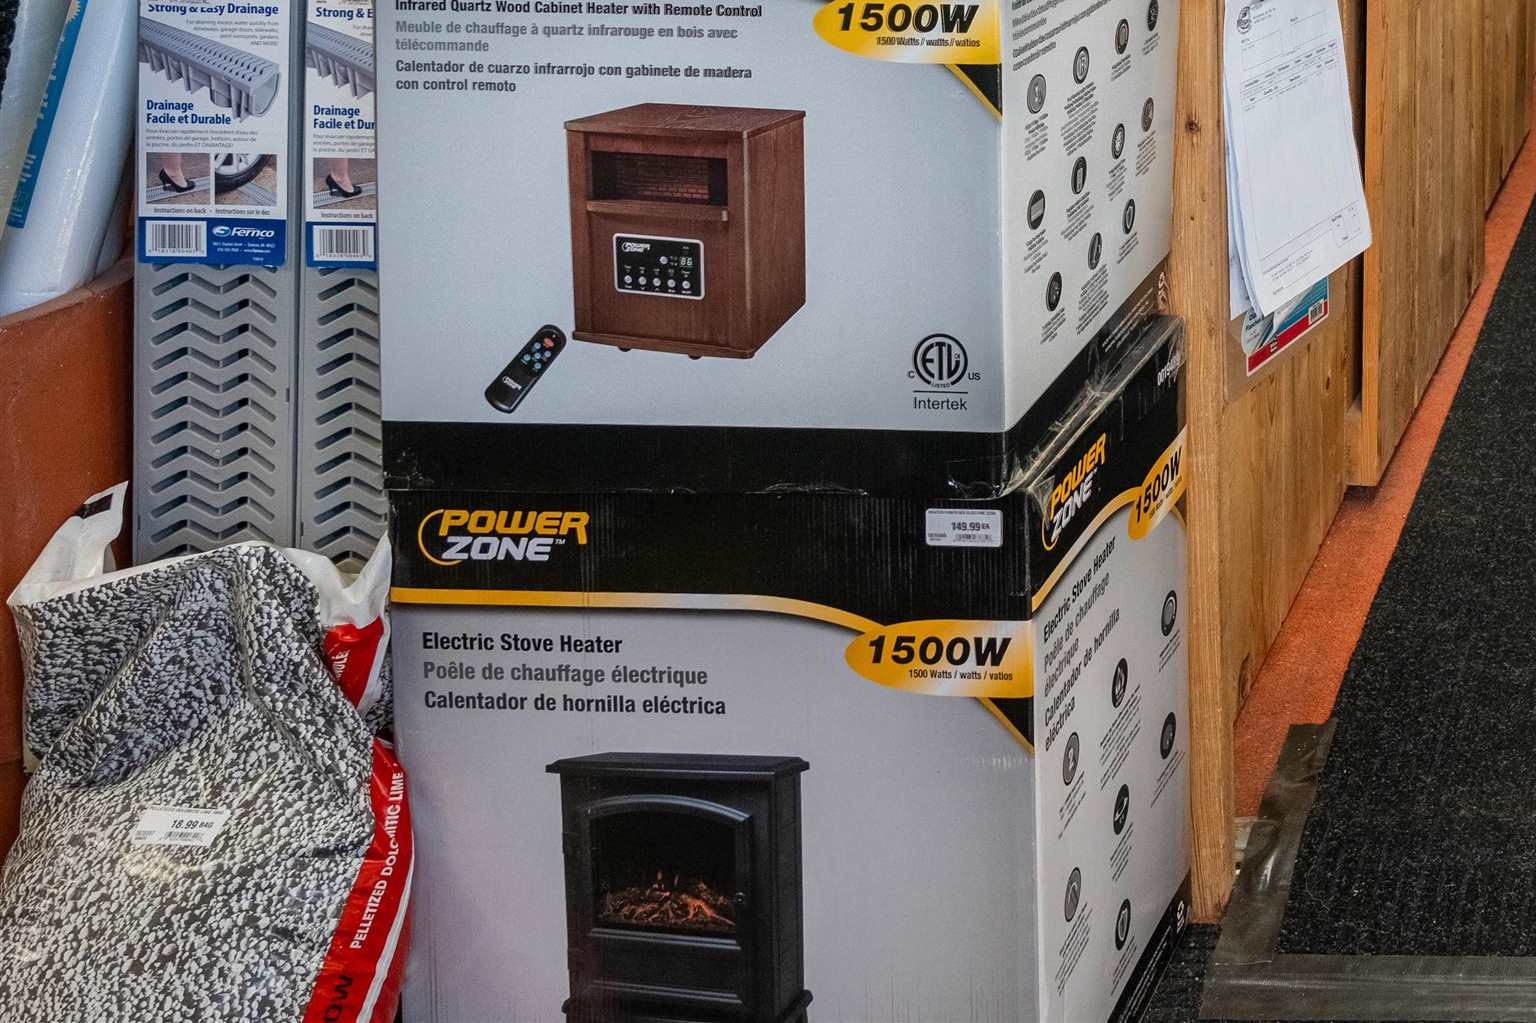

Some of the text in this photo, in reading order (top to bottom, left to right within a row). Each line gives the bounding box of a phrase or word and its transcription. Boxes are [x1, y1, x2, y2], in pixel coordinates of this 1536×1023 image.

[227, 3, 279, 17] Drainage
[315, 6, 354, 21] Strong
[395, 0, 763, 18] Infrared Quartz Wood Cabinet Heater with Remote Control
[838, 3, 979, 34] 1500W
[395, 20, 738, 40] Meuble de chauffage quartz infrarouge en bois avec
[395, 38, 489, 53] télécommande
[395, 60, 752, 80] Calentador de cuarzo infrarrojo con gabinete de madera
[395, 78, 517, 93] con control remoto
[146, 99, 194, 115] Drainage
[313, 104, 360, 119] Drainage
[146, 113, 232, 126] Facile Durable
[313, 117, 343, 130] Facile
[913, 396, 968, 410] Intertek
[1050, 433, 1107, 521] POWER
[1136, 446, 1182, 523] 1500W
[1051, 474, 1094, 544] ZONE
[438, 508, 590, 545] POWER
[440, 536, 553, 561] ZONE
[1043, 535, 1117, 644] Electric Stove Heater
[422, 632, 623, 654] Electric Stove Heater
[868, 635, 1012, 667] 1500W
[423, 661, 708, 688] Poêle de chauffage électrique
[908, 669, 982, 680] 1500 Watts watts
[1044, 663, 1082, 727] Calentador
[1093, 606, 1121, 654] hornilla
[424, 690, 727, 715] Calentador de hornilla eléctrica
[350, 878, 389, 950] PELLETIZED
